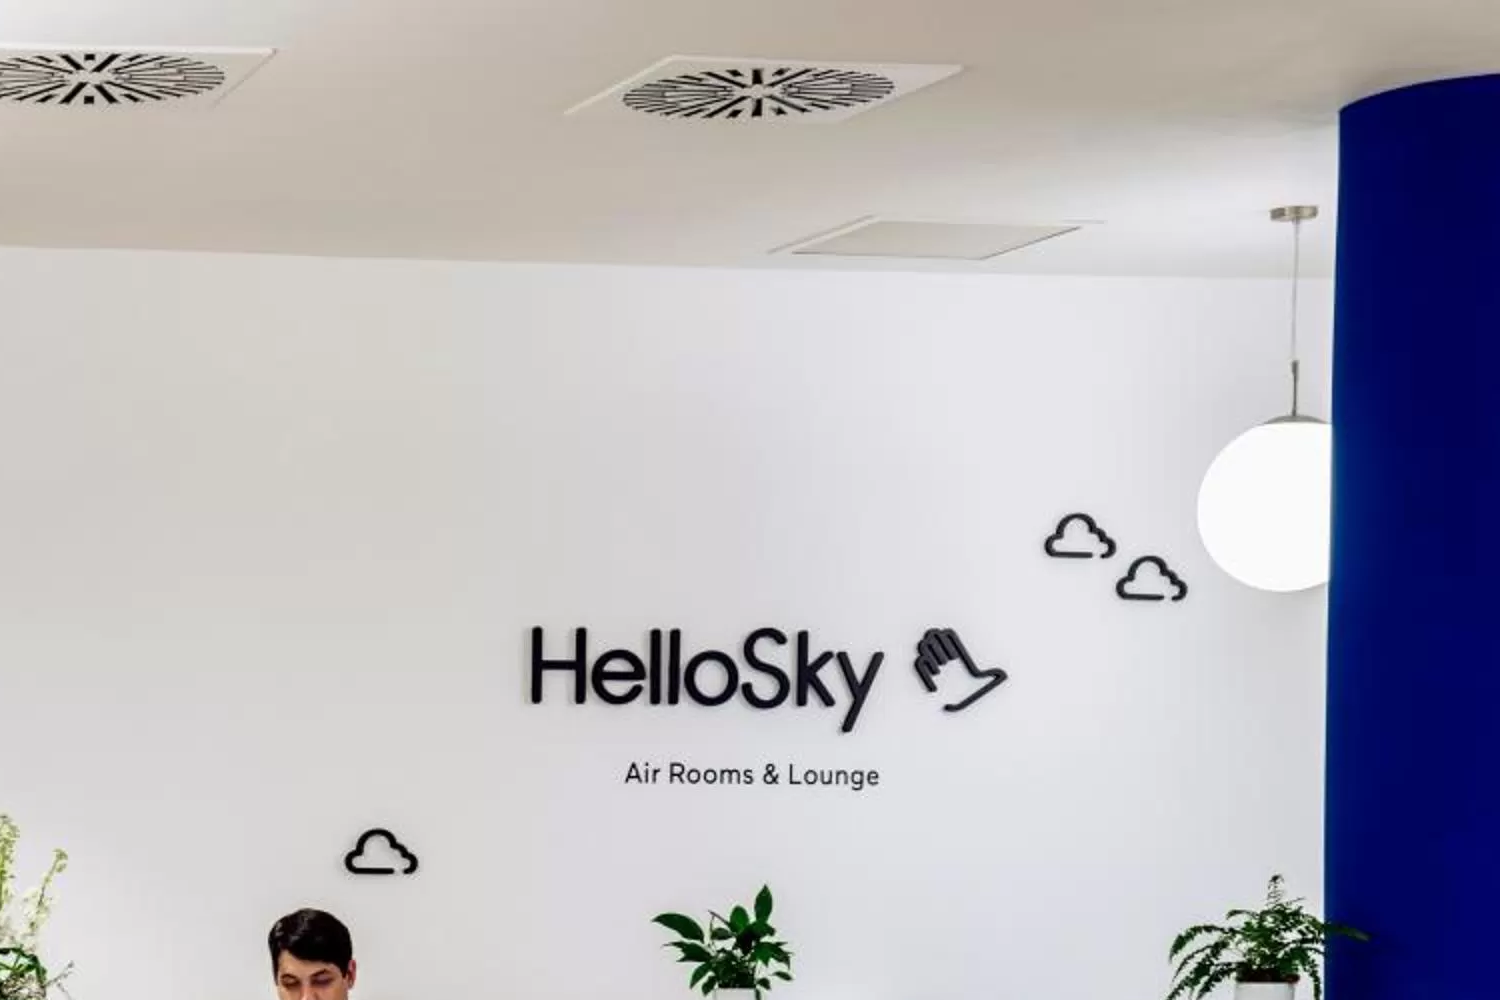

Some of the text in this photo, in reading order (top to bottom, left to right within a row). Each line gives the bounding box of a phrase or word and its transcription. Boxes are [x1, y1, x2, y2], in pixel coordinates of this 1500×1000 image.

[530, 626, 886, 734] HelloSky
[625, 762, 880, 791] Air Rooms & Lounge
